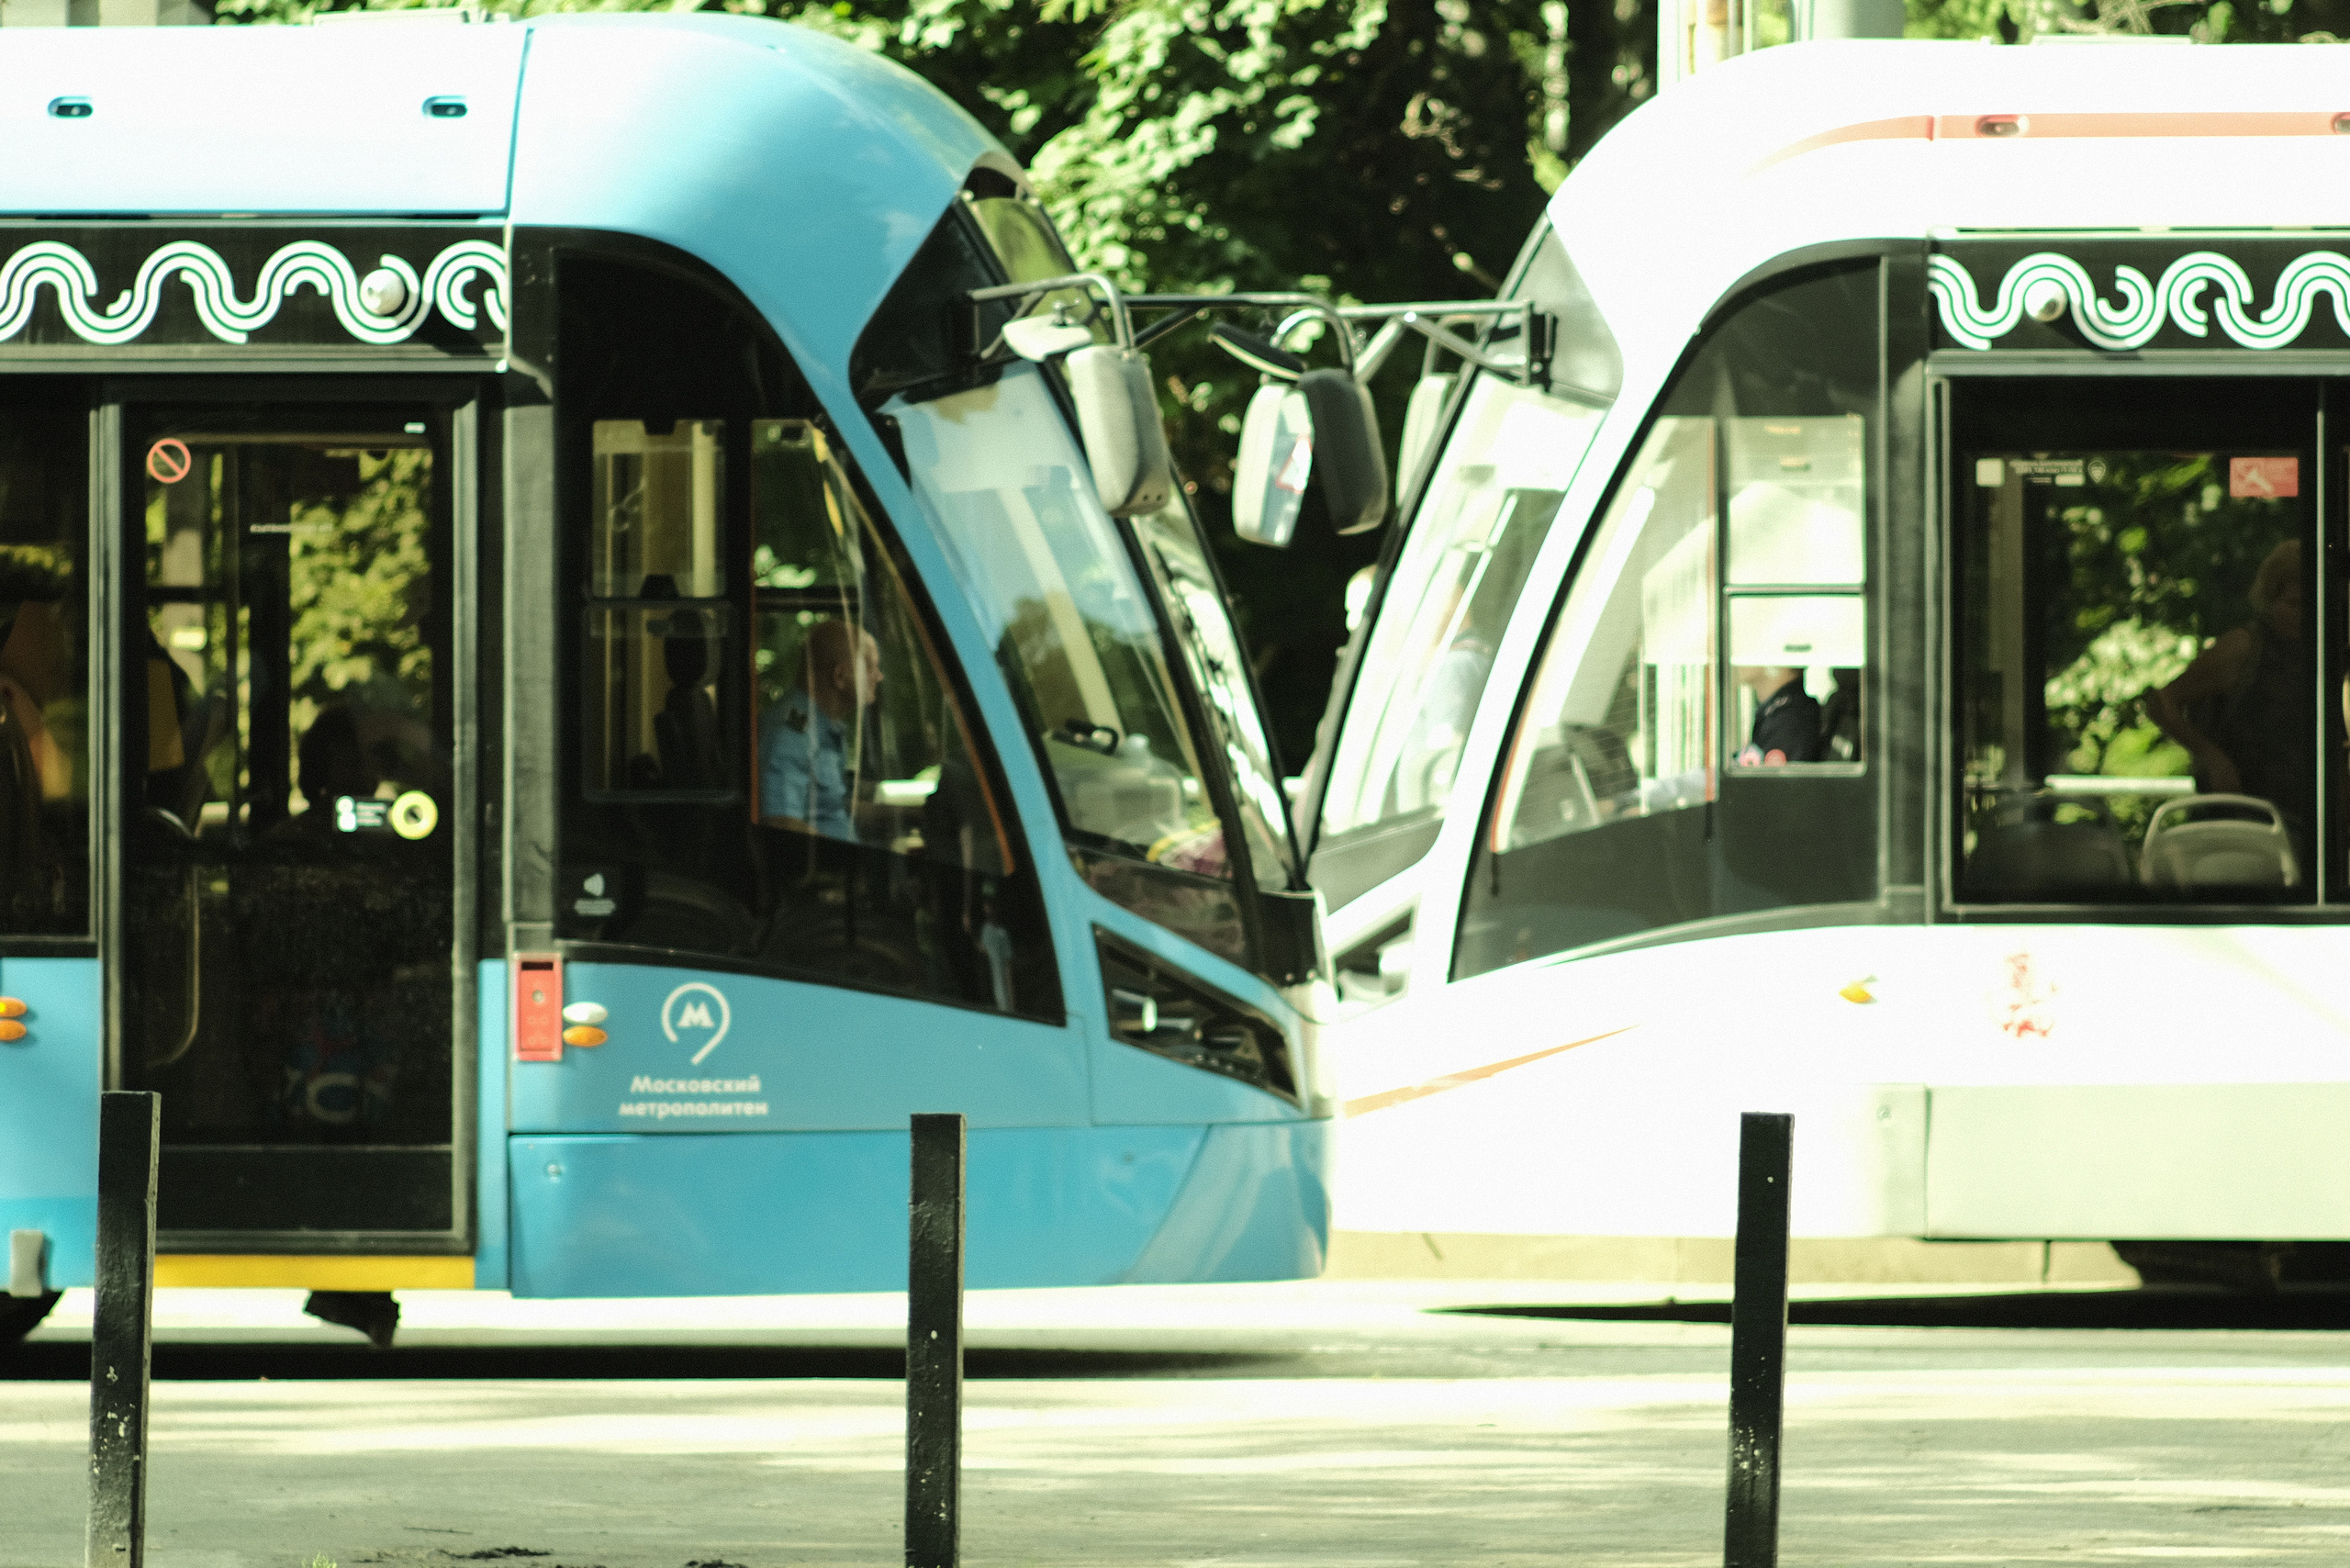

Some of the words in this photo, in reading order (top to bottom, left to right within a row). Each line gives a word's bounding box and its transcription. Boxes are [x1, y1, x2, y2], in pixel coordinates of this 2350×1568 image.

[677, 1002, 715, 1027] М
[630, 1075, 761, 1092] Московский
[619, 1103, 768, 1119] метрополитен
